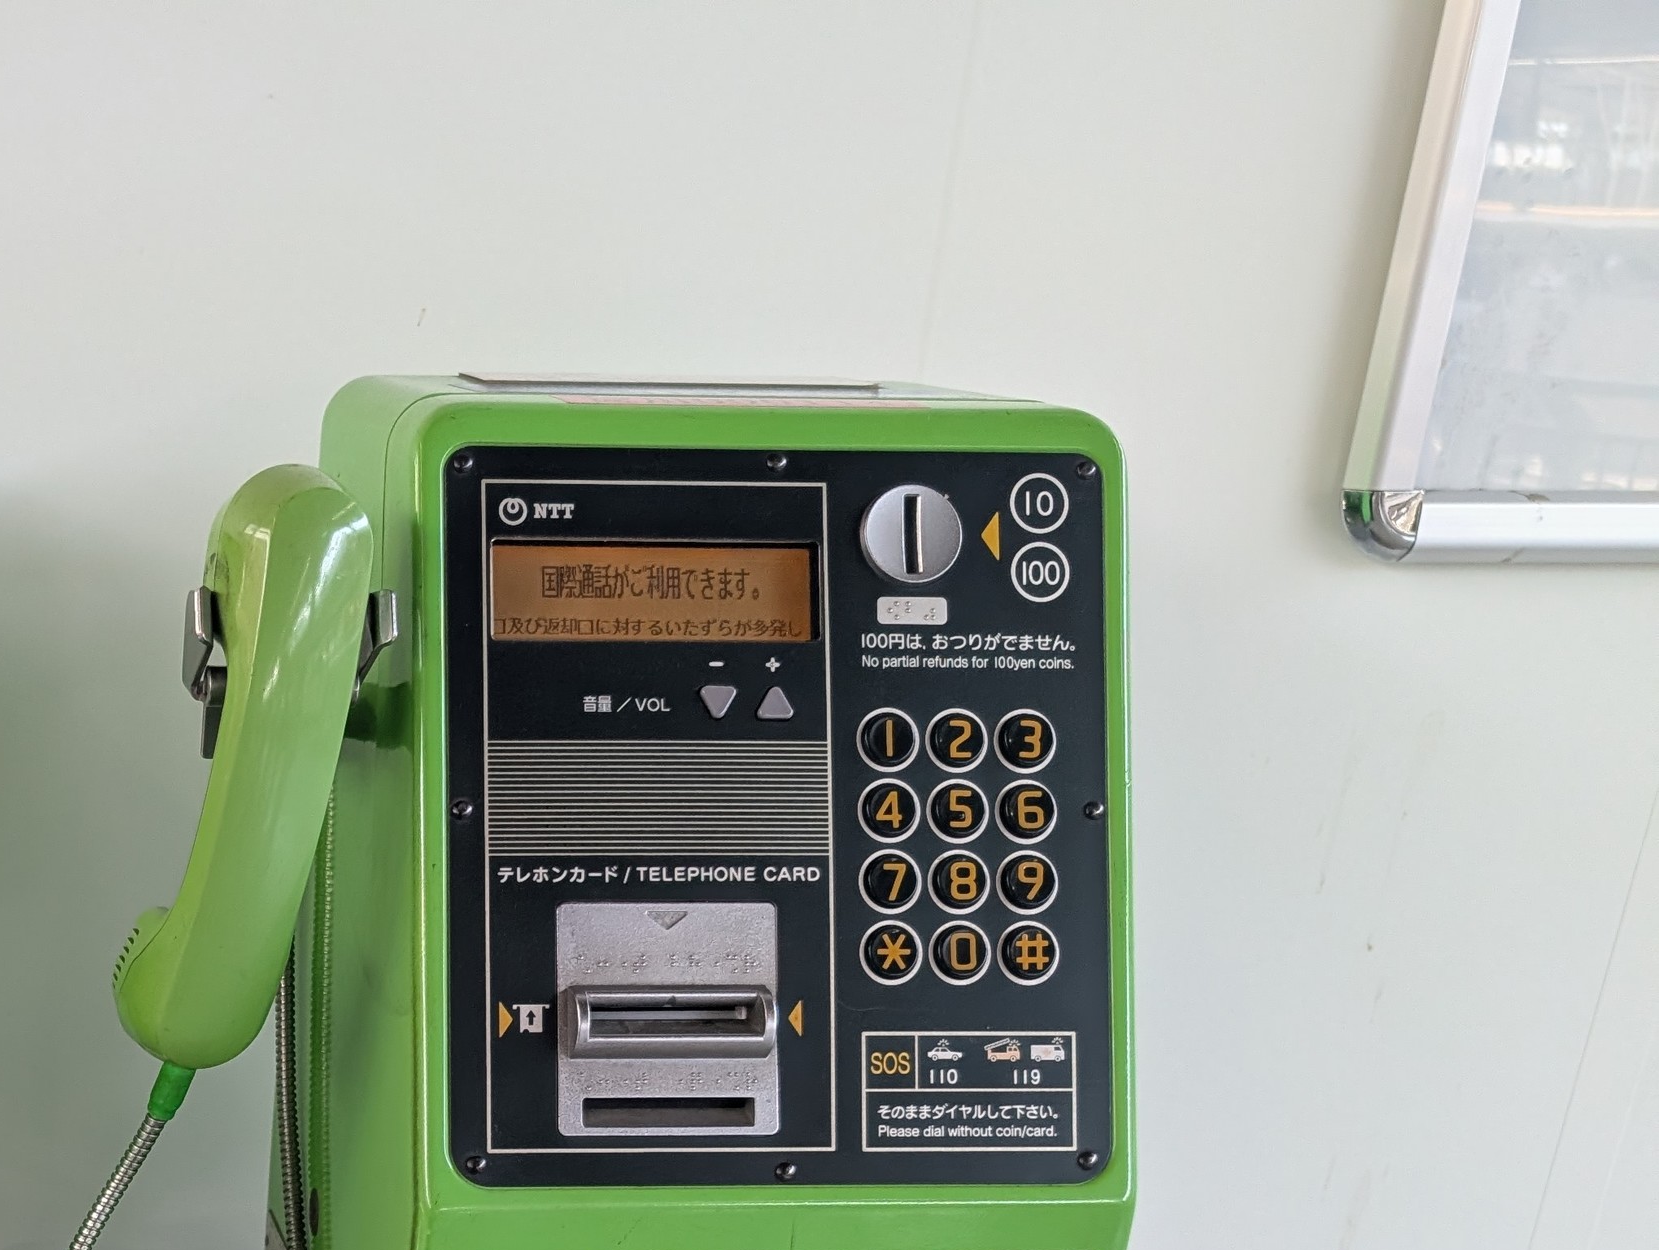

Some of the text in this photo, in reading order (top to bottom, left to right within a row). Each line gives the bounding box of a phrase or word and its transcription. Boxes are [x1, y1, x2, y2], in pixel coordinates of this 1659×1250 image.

[533, 503, 575, 519] NTT
[1025, 490, 1054, 516] 10
[541, 563, 760, 600] 国際通話がご利用できます。
[1022, 560, 1060, 586] 100
[861, 655, 1074, 671] No partial refunds for 100yen coins.
[582, 696, 612, 713] 音量
[634, 697, 670, 712] VOL
[886, 721, 894, 758] 1
[949, 720, 972, 757] 2
[1020, 720, 1042, 758] 3
[876, 791, 902, 826] 4
[949, 790, 973, 827] 5
[1017, 791, 1044, 828] 6
[497, 866, 618, 883] テレホンカード
[637, 867, 756, 882] TELEPHONE
[763, 867, 820, 882] CARD
[884, 864, 907, 899] 7
[950, 862, 977, 899] 8
[1017, 862, 1044, 898] 9
[950, 933, 977, 970] 0
[870, 1052, 911, 1074] SOS
[929, 1069, 958, 1084] 110
[1013, 1069, 1041, 1084] 119
[877, 1104, 1059, 1119] そのままダイヤルして下さい。
[878, 1125, 1058, 1137] Please dial without coin/card.
